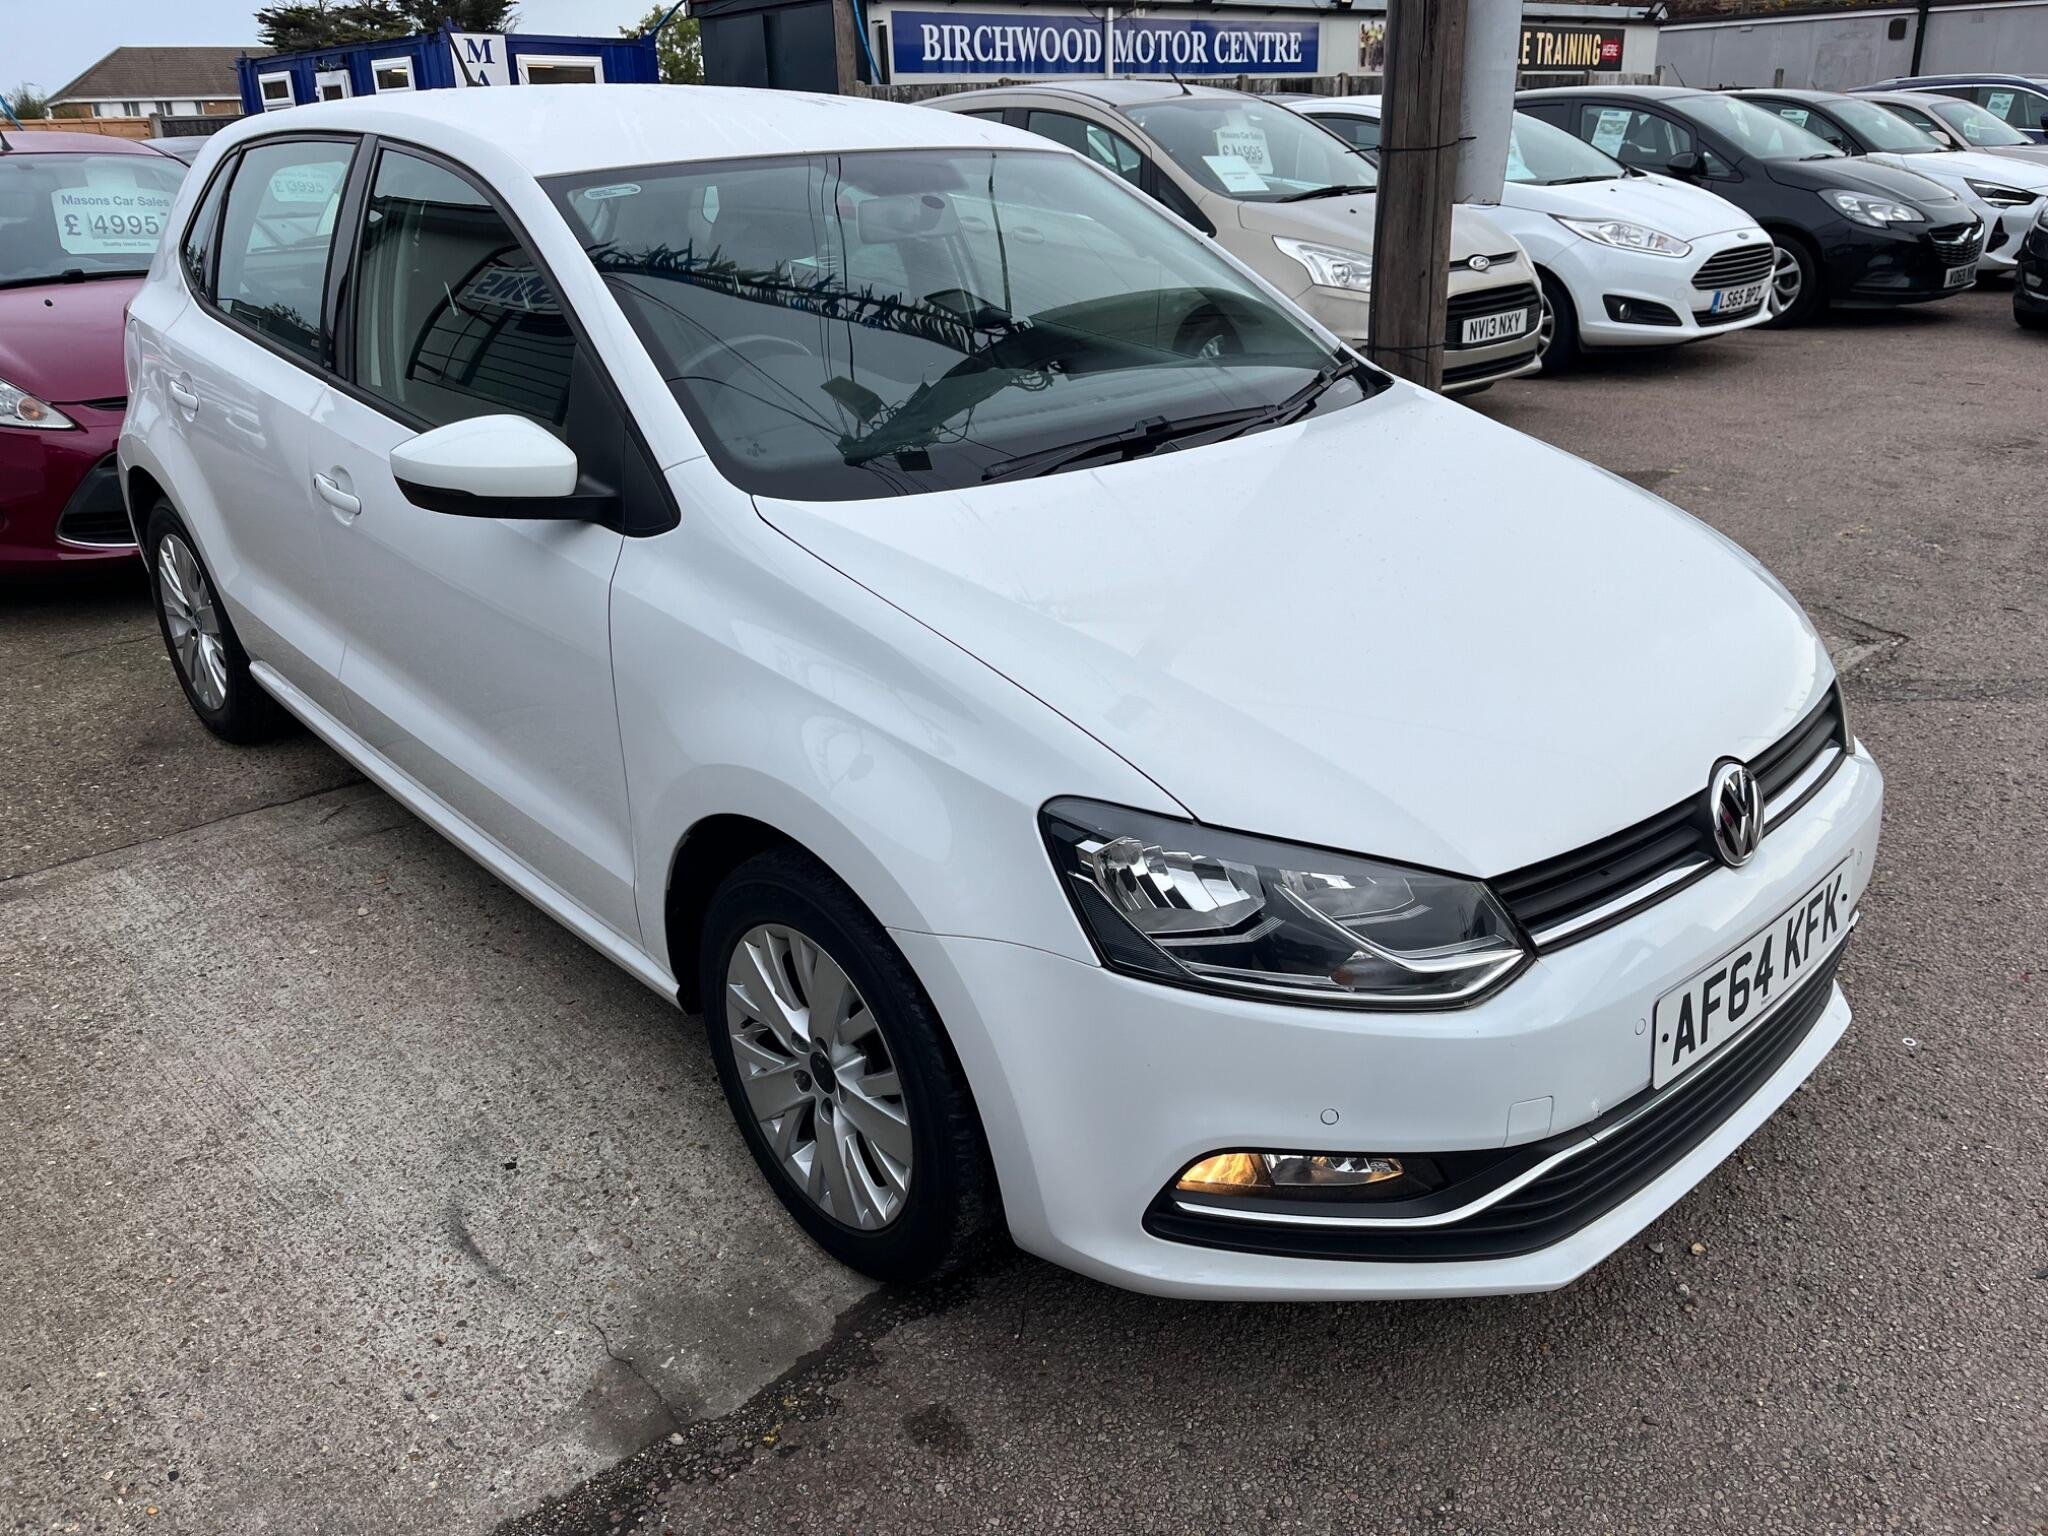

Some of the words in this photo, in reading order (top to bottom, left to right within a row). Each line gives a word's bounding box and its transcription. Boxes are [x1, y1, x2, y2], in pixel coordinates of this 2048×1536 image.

[921, 24, 1102, 63] BIRCHWOOD
[1113, 30, 1209, 64] MOTOR
[1214, 31, 1302, 63] CENTRE
[1536, 32, 1601, 65] TRAINING
[61, 195, 110, 206] Masons
[113, 196, 134, 206] Car
[138, 196, 170, 207] Sales
[64, 213, 82, 236] £
[94, 214, 159, 235] 4995
[1719, 290, 1744, 309] LS65
[1469, 317, 1497, 340] NV13
[1499, 311, 1521, 334] NXY
[1672, 934, 1774, 1066] AF64
[1783, 873, 1842, 981] KFK
